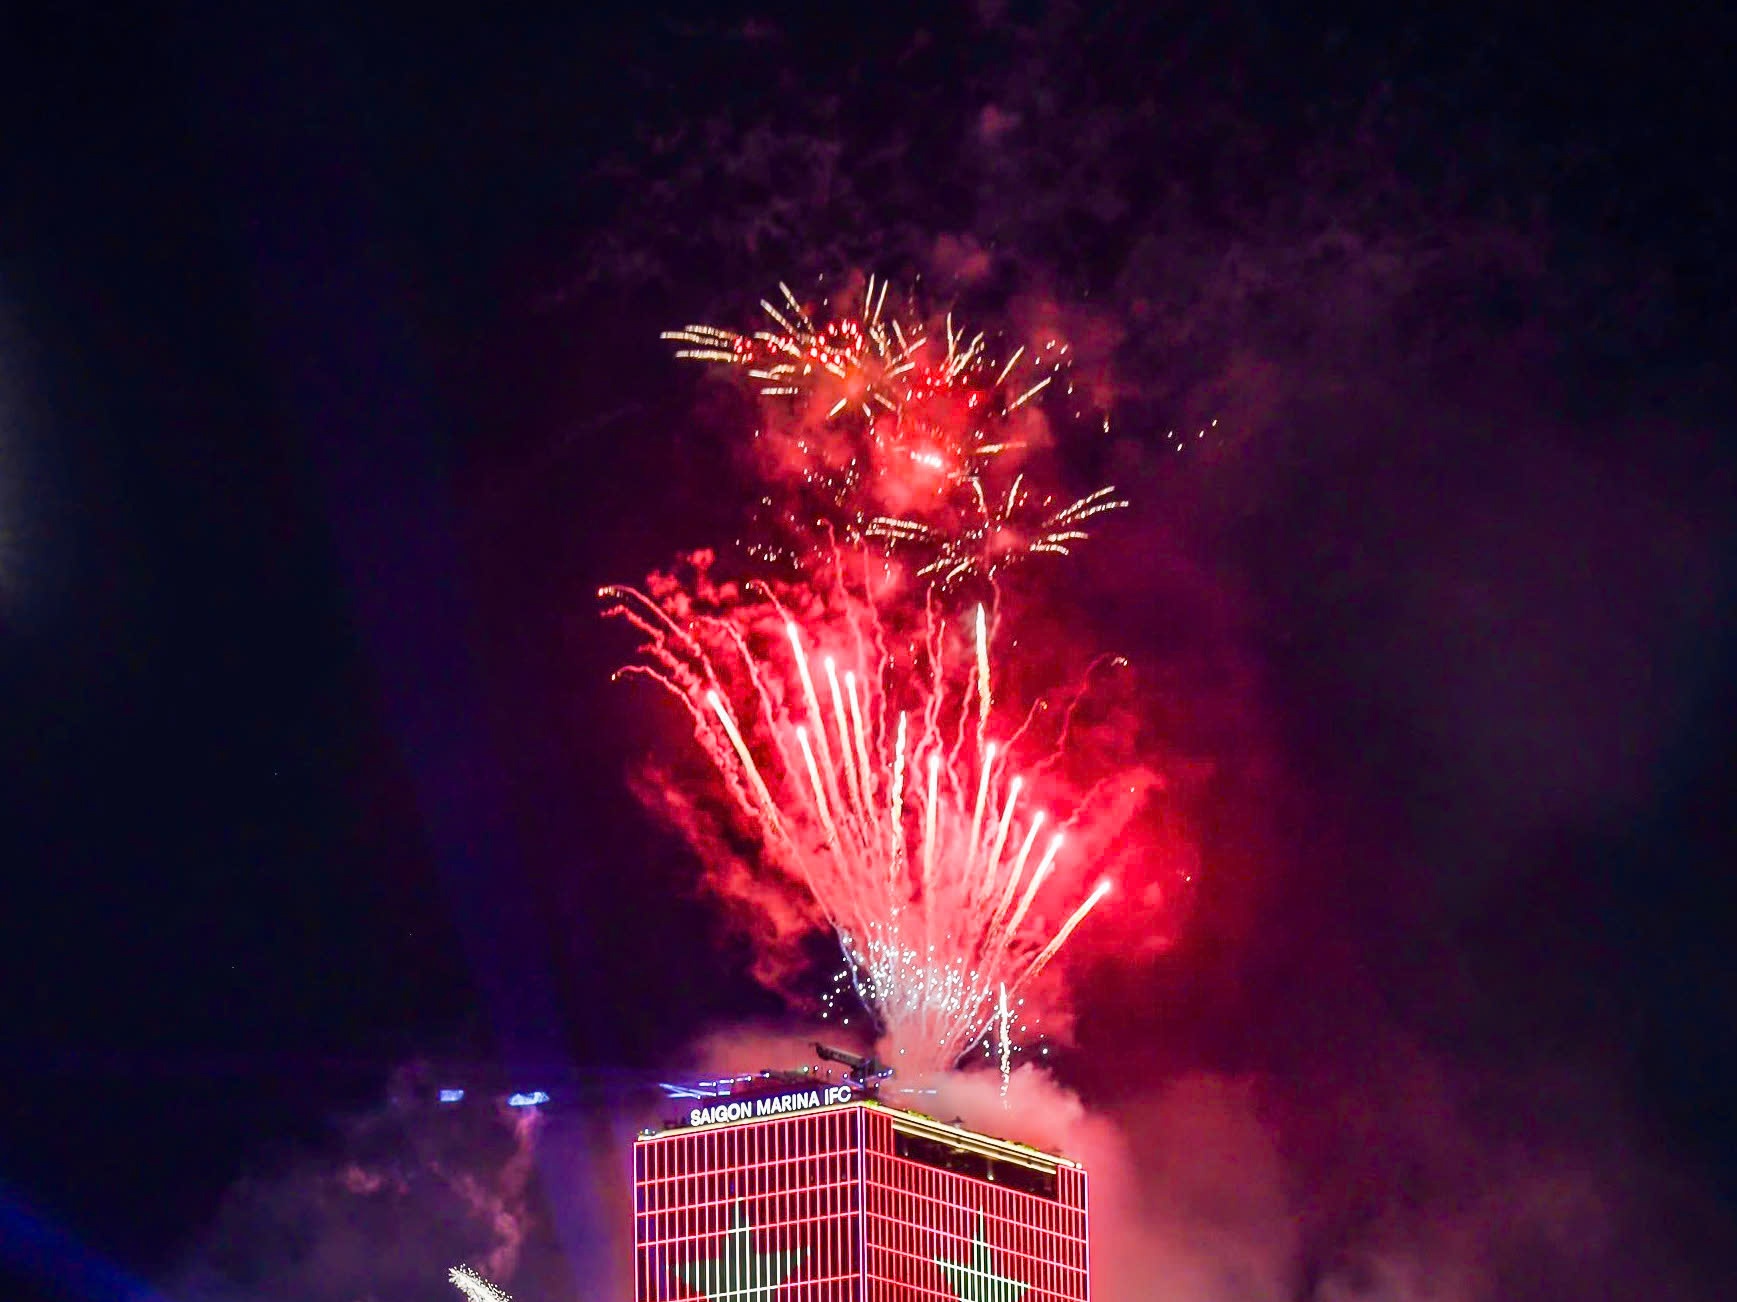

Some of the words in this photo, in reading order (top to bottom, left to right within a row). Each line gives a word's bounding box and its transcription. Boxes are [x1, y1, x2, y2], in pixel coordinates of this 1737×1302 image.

[690, 1101, 752, 1127] SAIGON
[756, 1090, 820, 1116] MARINA
[824, 1085, 852, 1106] IFC
